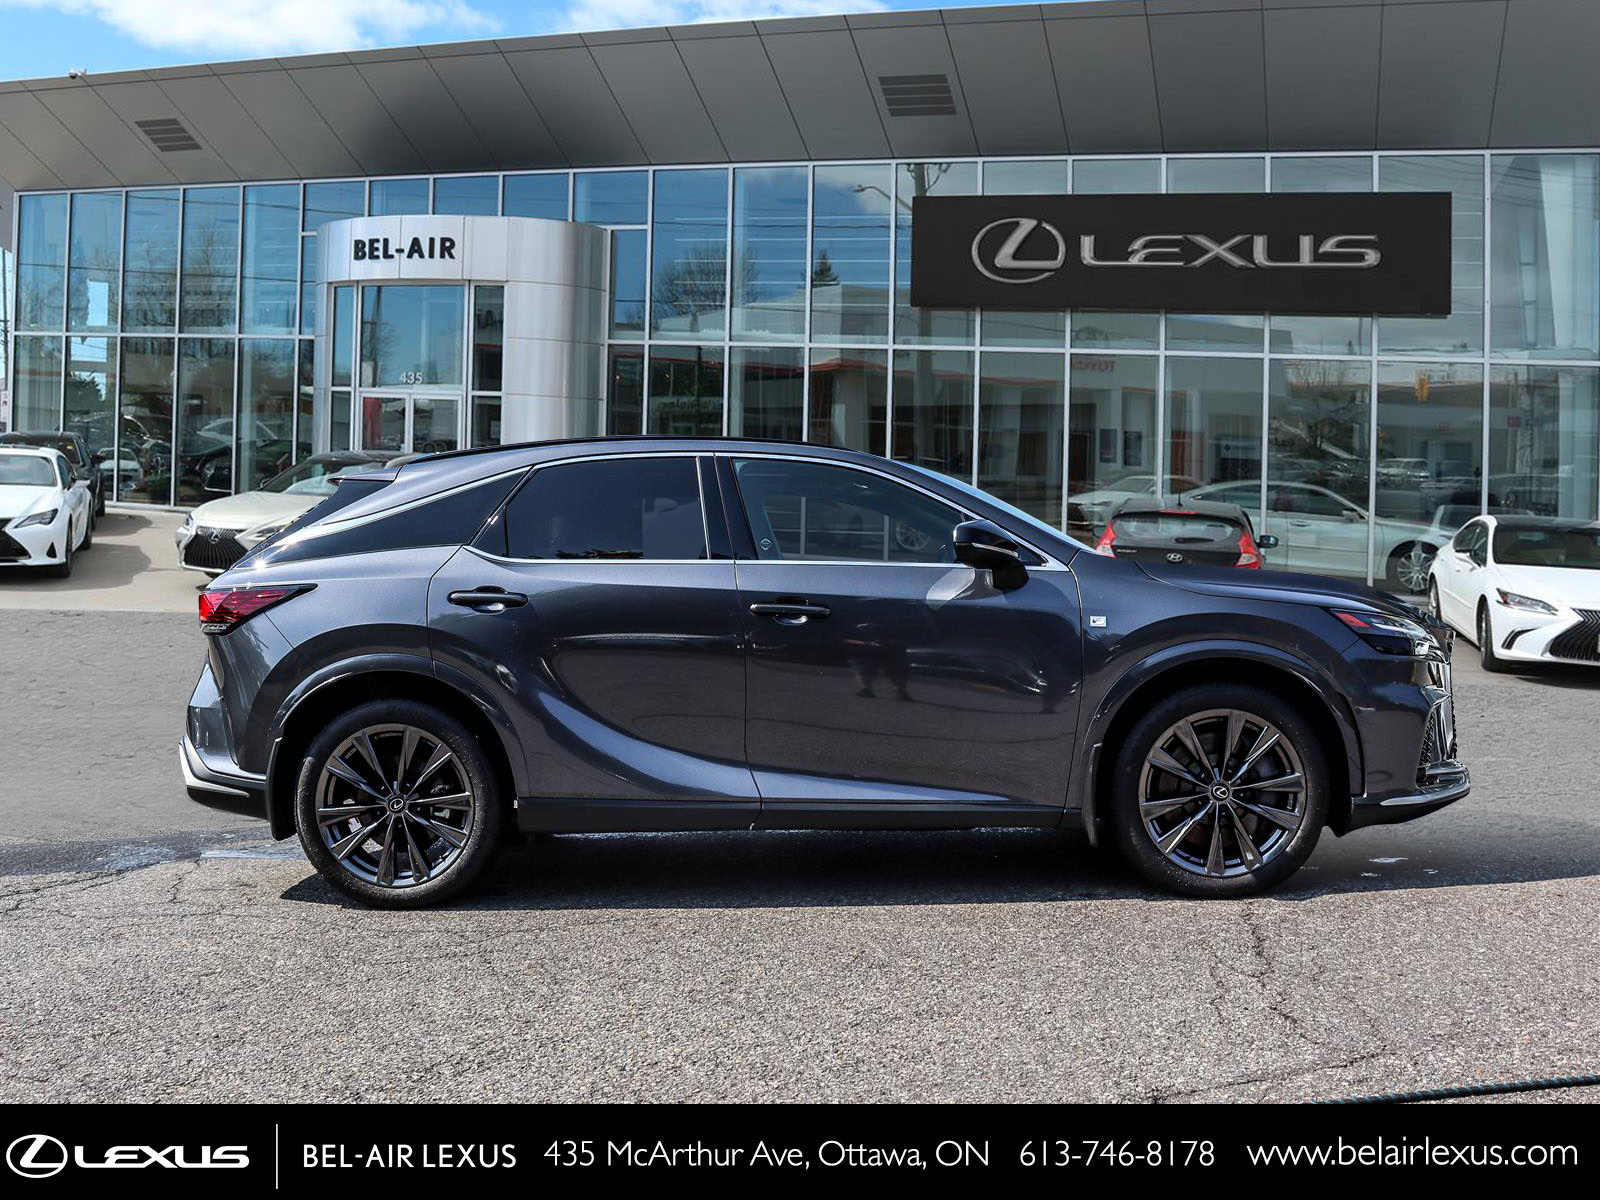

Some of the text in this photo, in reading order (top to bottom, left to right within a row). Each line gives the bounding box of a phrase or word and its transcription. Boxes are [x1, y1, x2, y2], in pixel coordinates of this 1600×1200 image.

[353, 236, 456, 261] BEL-AIR
[1079, 234, 1381, 268] LEXUS
[400, 371, 423, 385] 435
